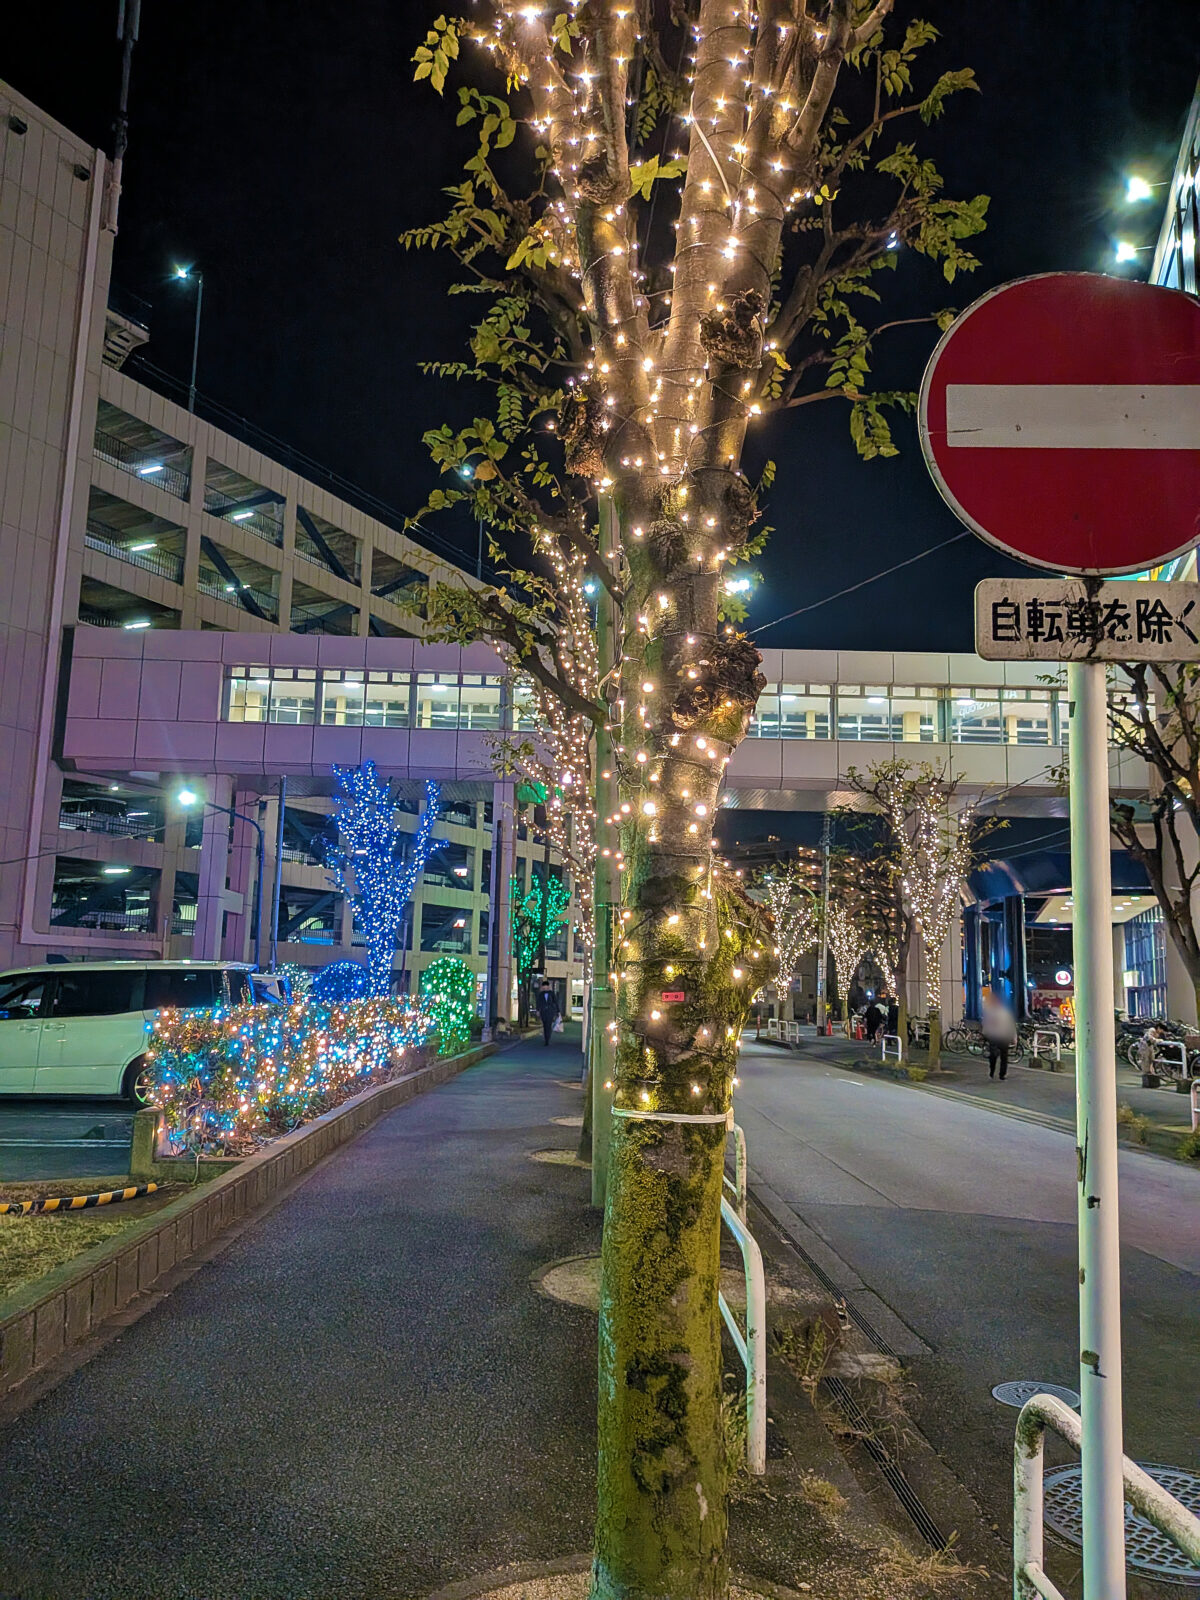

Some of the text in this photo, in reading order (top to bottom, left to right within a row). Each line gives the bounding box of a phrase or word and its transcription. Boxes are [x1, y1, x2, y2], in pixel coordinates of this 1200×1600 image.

[992, 597, 1200, 644] 自転車を除く
